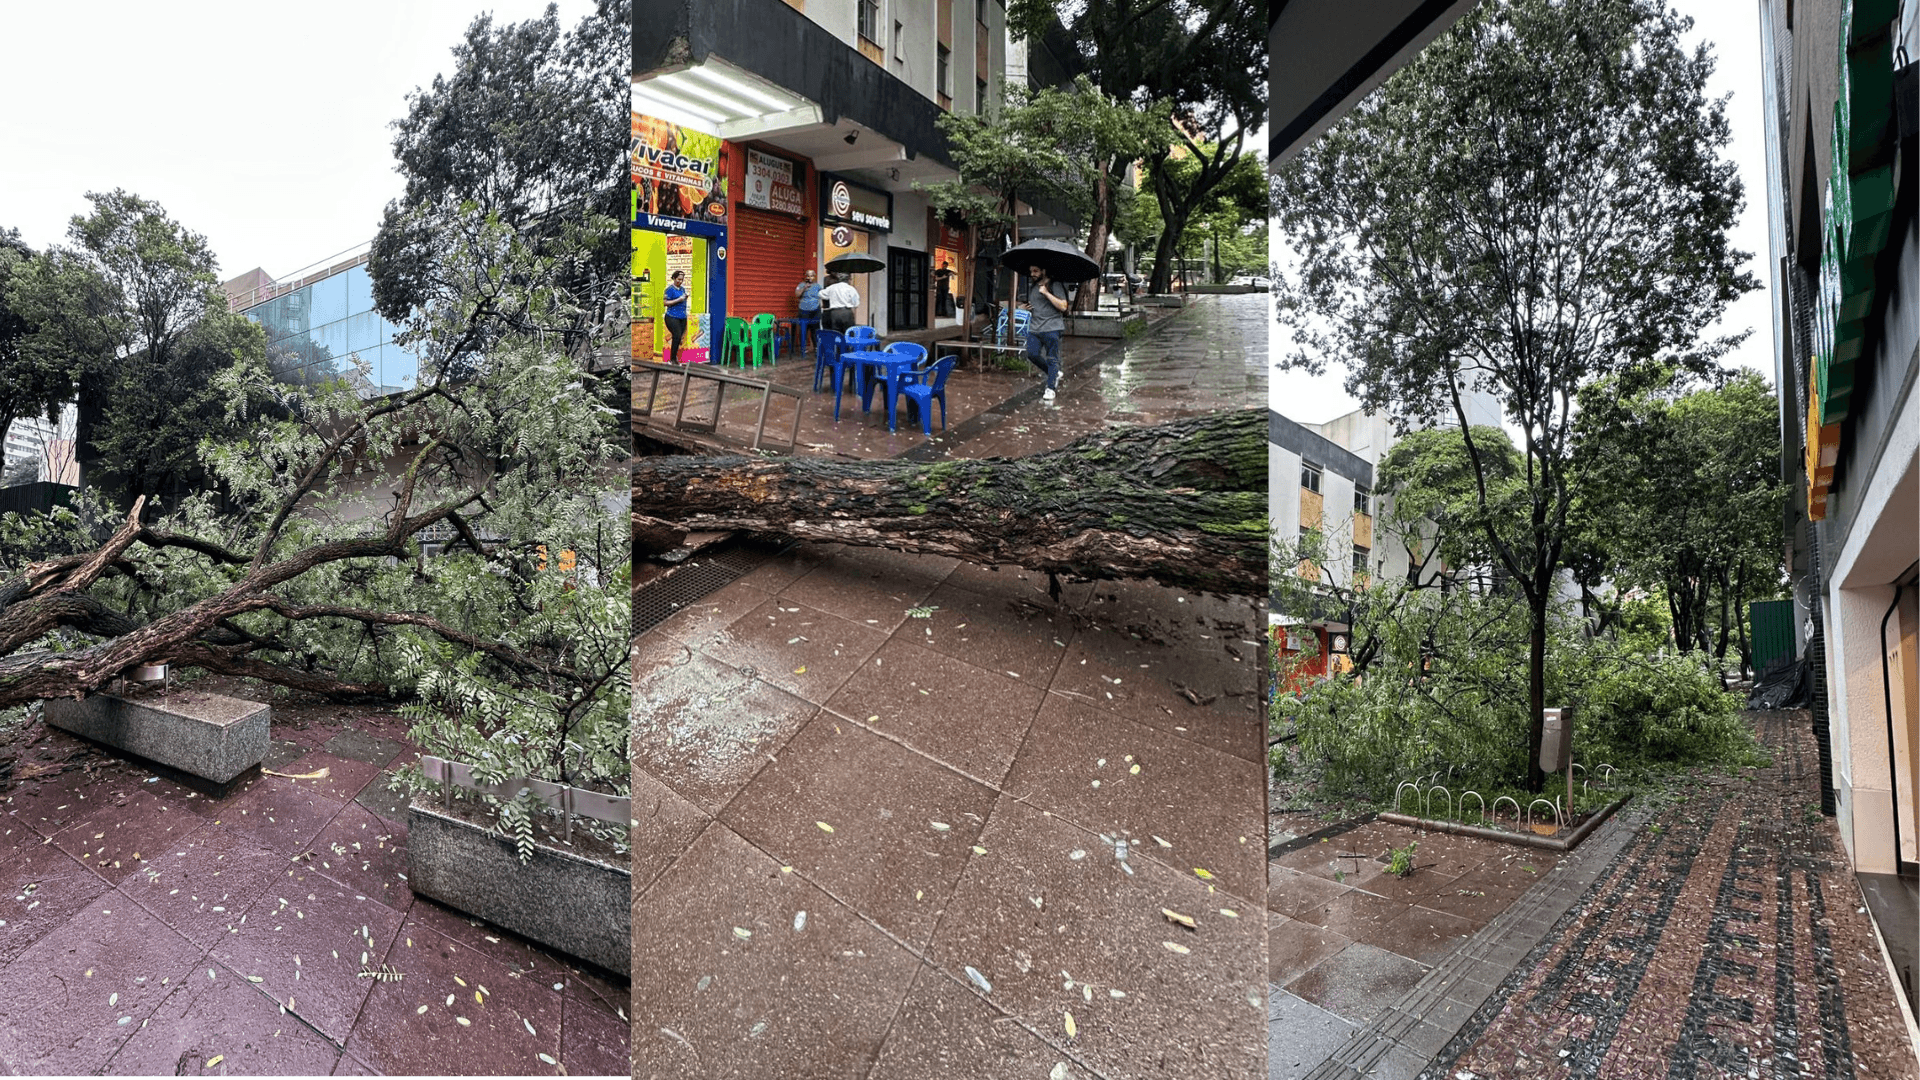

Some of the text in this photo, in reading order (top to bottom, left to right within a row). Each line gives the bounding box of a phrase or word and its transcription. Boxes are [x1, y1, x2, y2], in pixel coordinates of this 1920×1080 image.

[759, 156, 784, 170] ALUGUE
[631, 164, 702, 187] UCOS E VITAMINAS
[771, 185, 801, 204] ALUGA
[852, 210, 890, 229] seu sorvete
